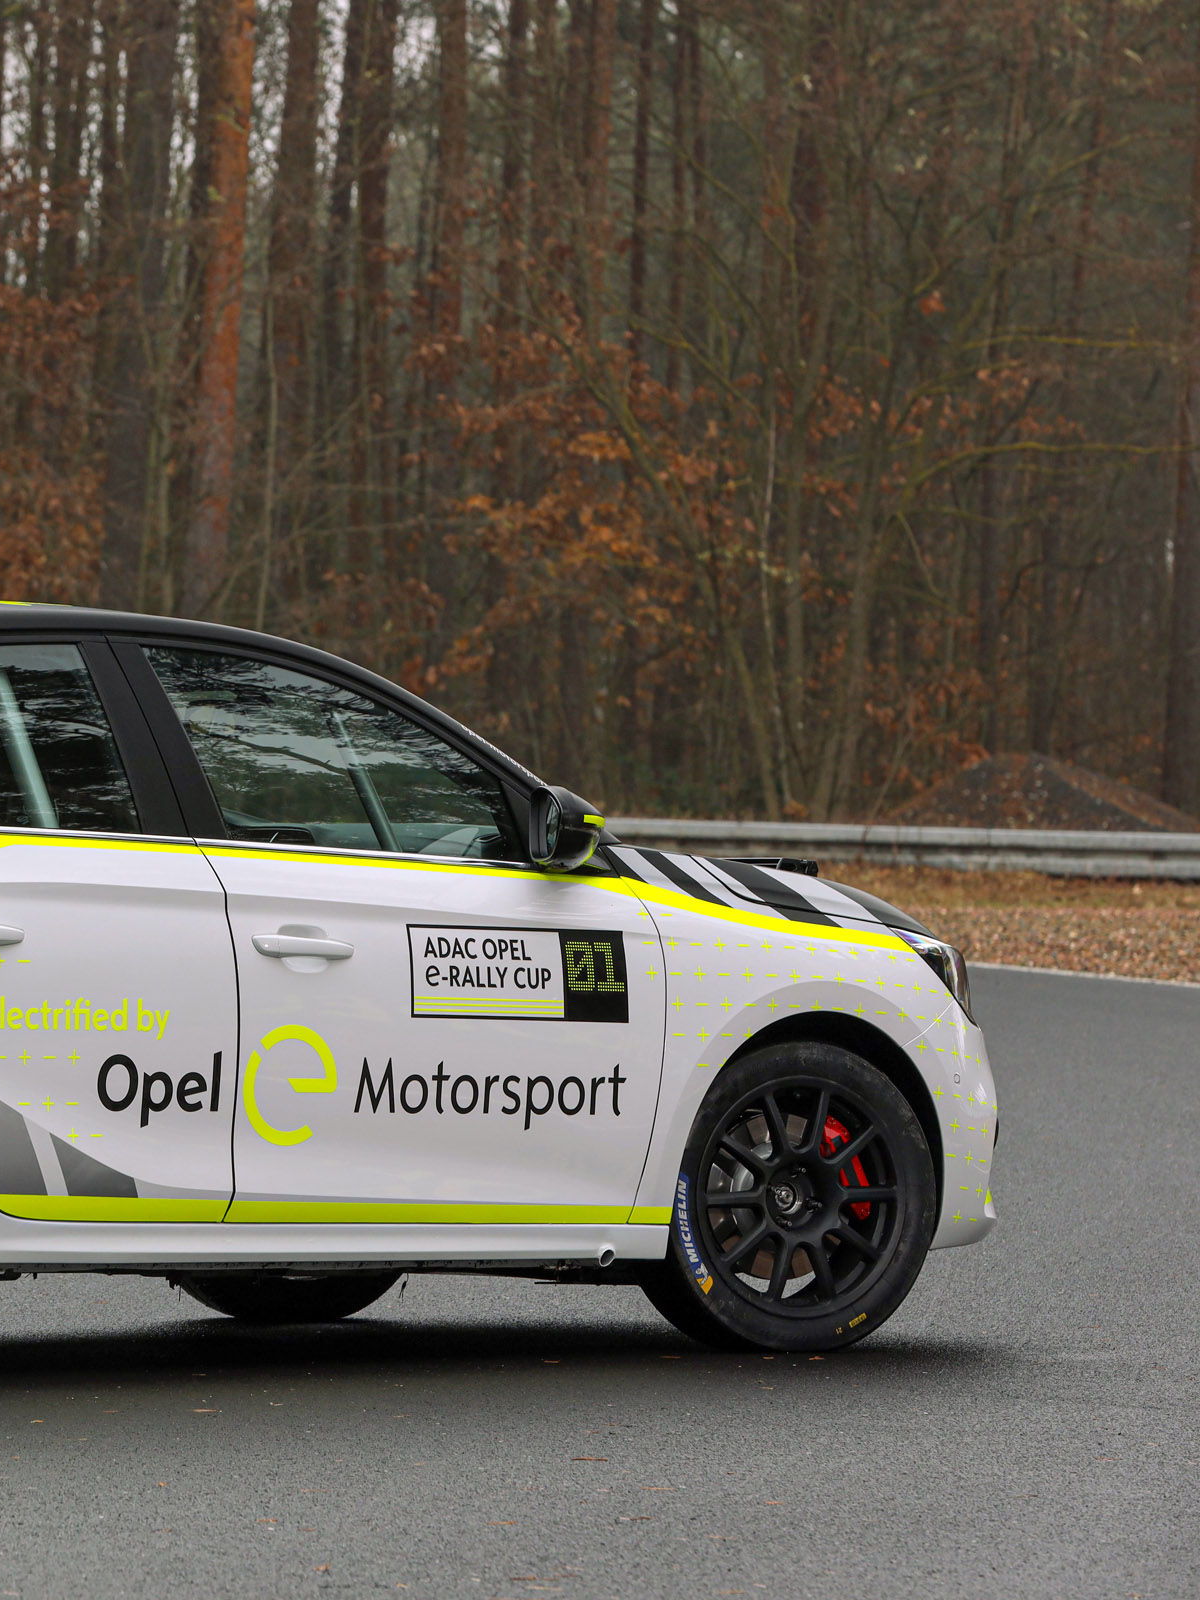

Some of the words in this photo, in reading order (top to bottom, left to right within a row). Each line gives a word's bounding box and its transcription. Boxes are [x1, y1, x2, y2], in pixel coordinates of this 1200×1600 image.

[423, 936, 478, 960] ADAC
[481, 938, 532, 961] OPEL
[564, 941, 625, 993] 01
[425, 964, 508, 989] e-RALLY
[513, 967, 552, 990] CUP
[136, 999, 171, 1041] by
[97, 1051, 223, 1129] Opel
[353, 1057, 628, 1132] Motorsport
[677, 1179, 699, 1263] MICHELIN
